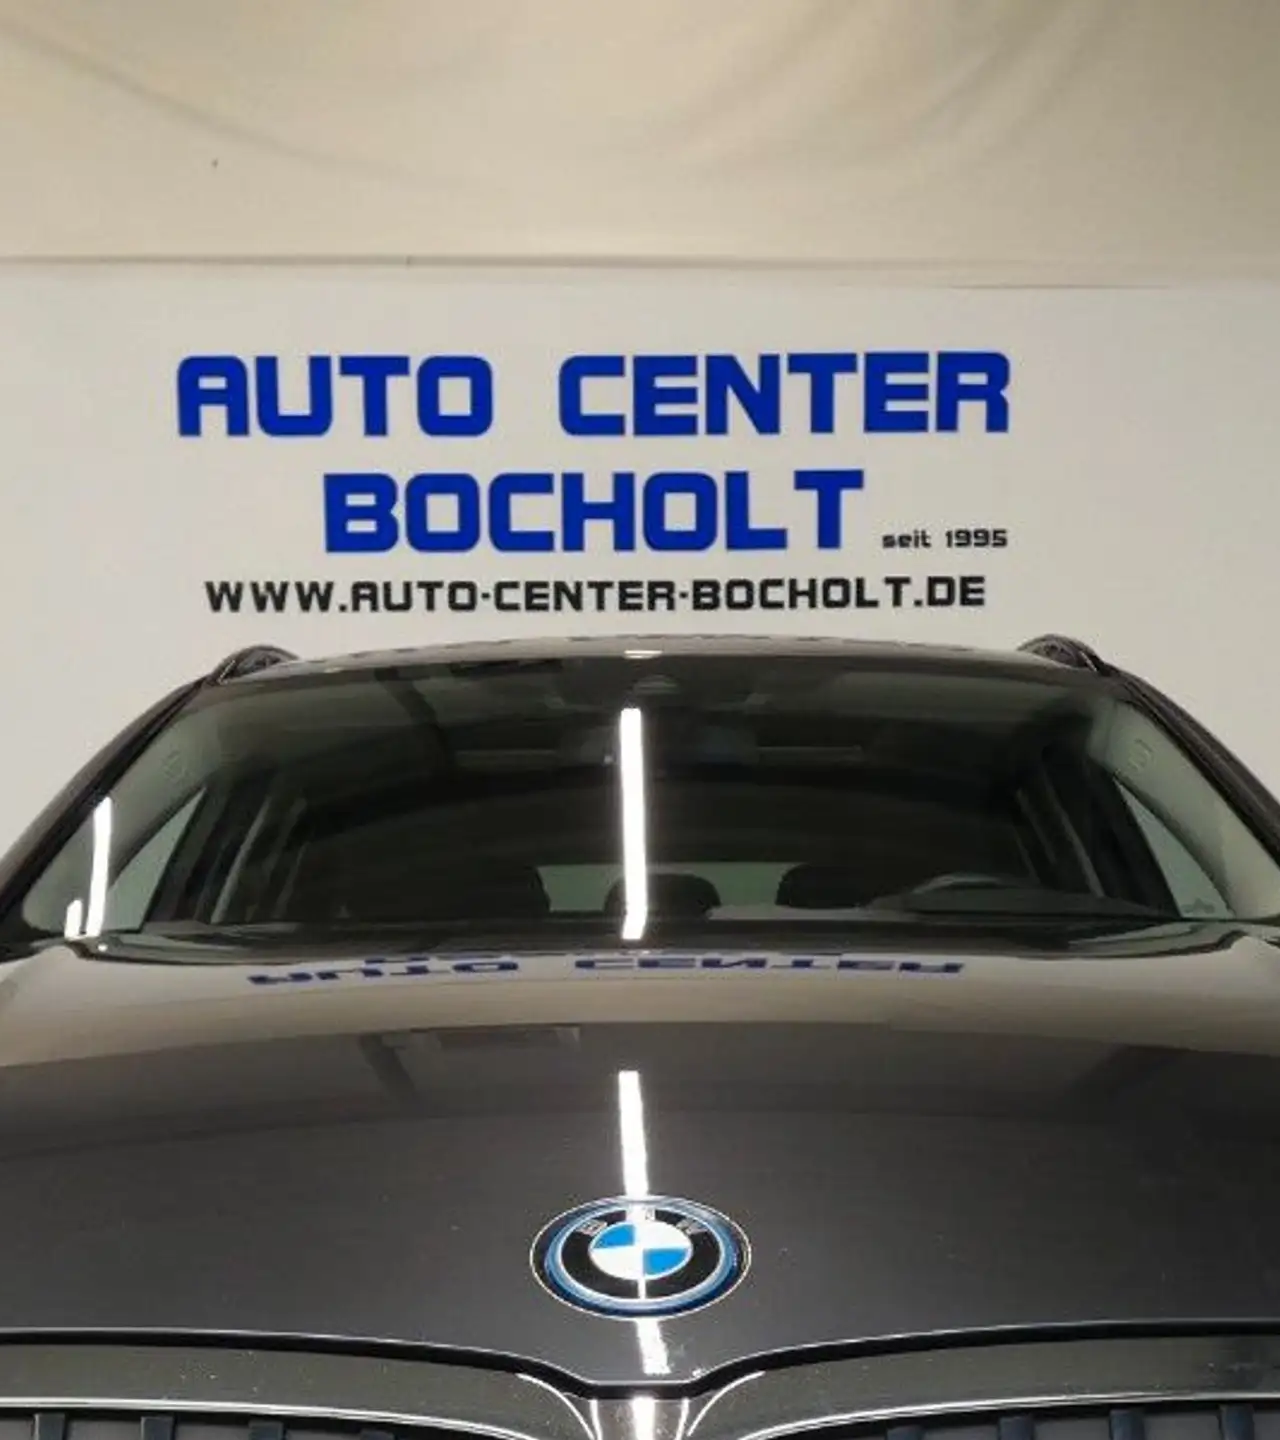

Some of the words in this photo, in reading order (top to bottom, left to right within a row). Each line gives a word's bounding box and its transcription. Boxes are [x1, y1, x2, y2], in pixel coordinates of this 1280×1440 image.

[177, 354, 495, 438] AUTO
[557, 350, 1011, 437] CENTER
[322, 468, 864, 555] BOCHOLT
[881, 529, 932, 549] seit
[945, 528, 1008, 549] 1995
[205, 575, 986, 614] WWW.AUTO-CENTER-BOCHOLT.DE
